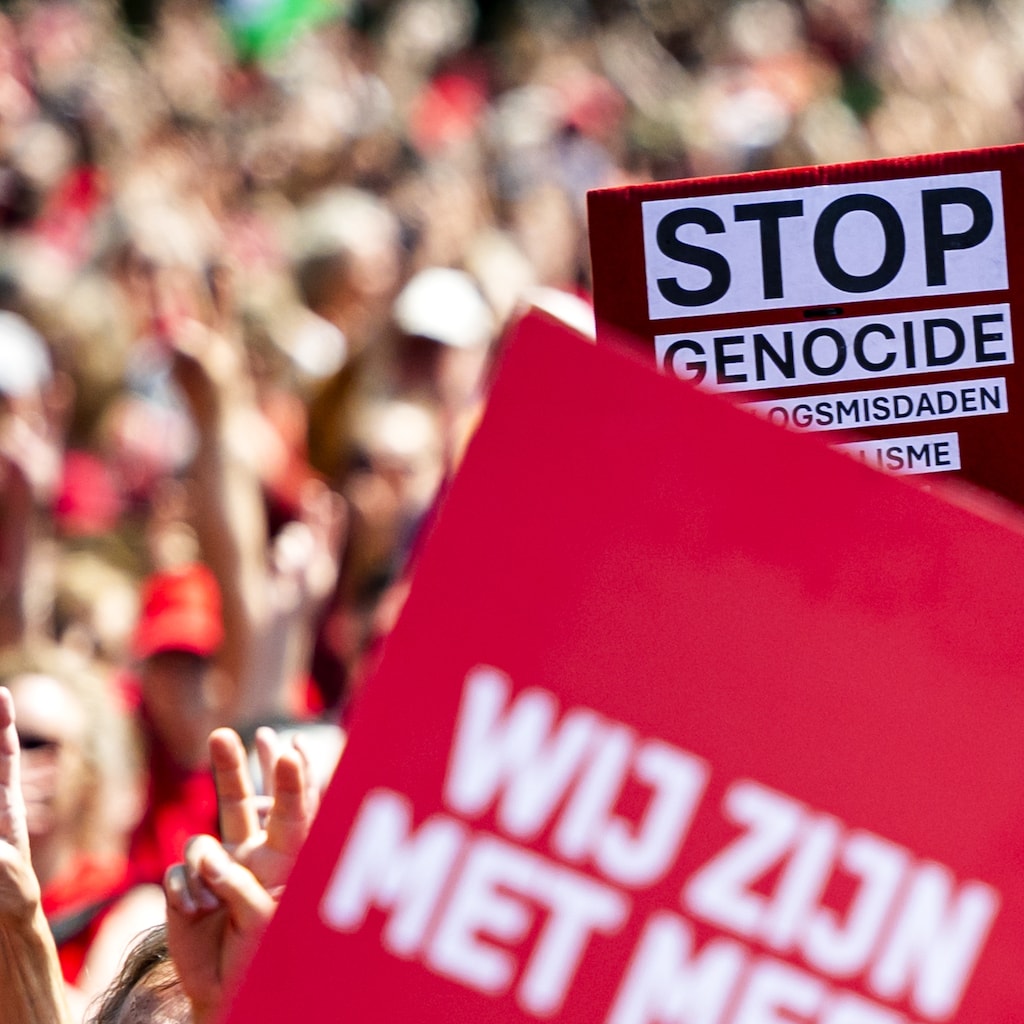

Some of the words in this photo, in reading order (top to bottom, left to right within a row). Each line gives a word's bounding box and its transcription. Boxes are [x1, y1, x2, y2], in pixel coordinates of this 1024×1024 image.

[655, 186, 994, 306] STOP
[663, 314, 1007, 387] GENOCIDE
[750, 386, 1001, 428] OGSMISDADEN
[446, 664, 709, 886] WIJ
[684, 779, 1000, 1019] ZIJN
[321, 789, 630, 1015] MET
